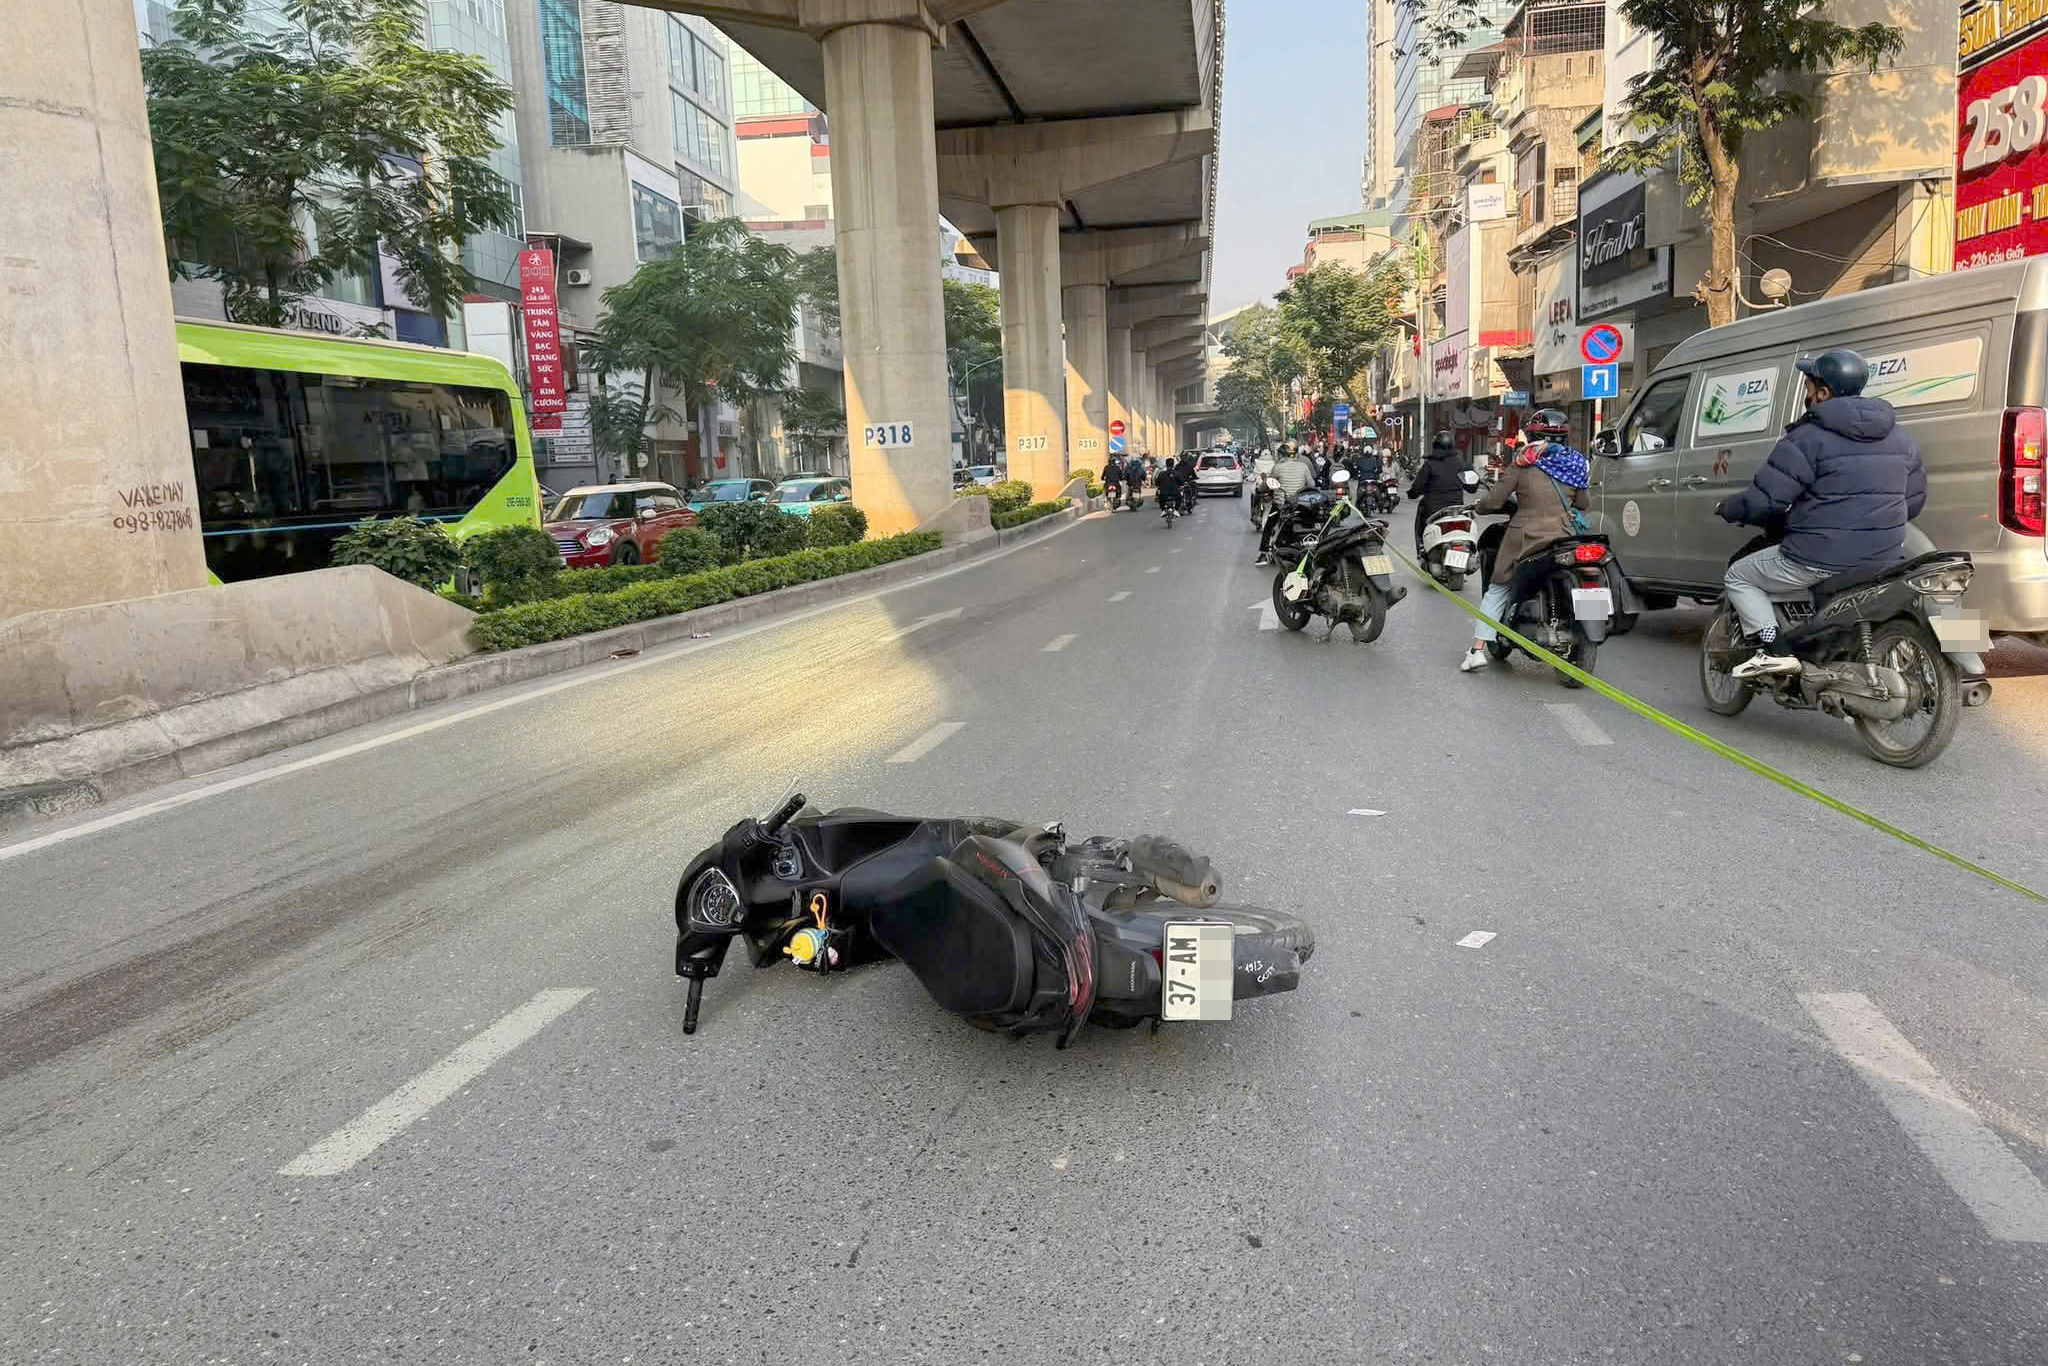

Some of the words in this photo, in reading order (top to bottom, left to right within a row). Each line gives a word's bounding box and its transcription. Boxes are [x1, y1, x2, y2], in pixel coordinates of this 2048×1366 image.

[1962, 75, 2048, 172] 258
[1970, 251, 1987, 268] 226
[526, 308, 554, 316] TRUNG
[532, 319, 550, 328] TÂM
[530, 329, 554, 338] VÀNG
[535, 342, 552, 352] BẠC
[531, 354, 558, 362] TRANG
[865, 425, 911, 446] P318
[1018, 437, 1046, 450] P317
[1078, 440, 1098, 449] P316
[1168, 937, 1197, 1006] 37-AM
